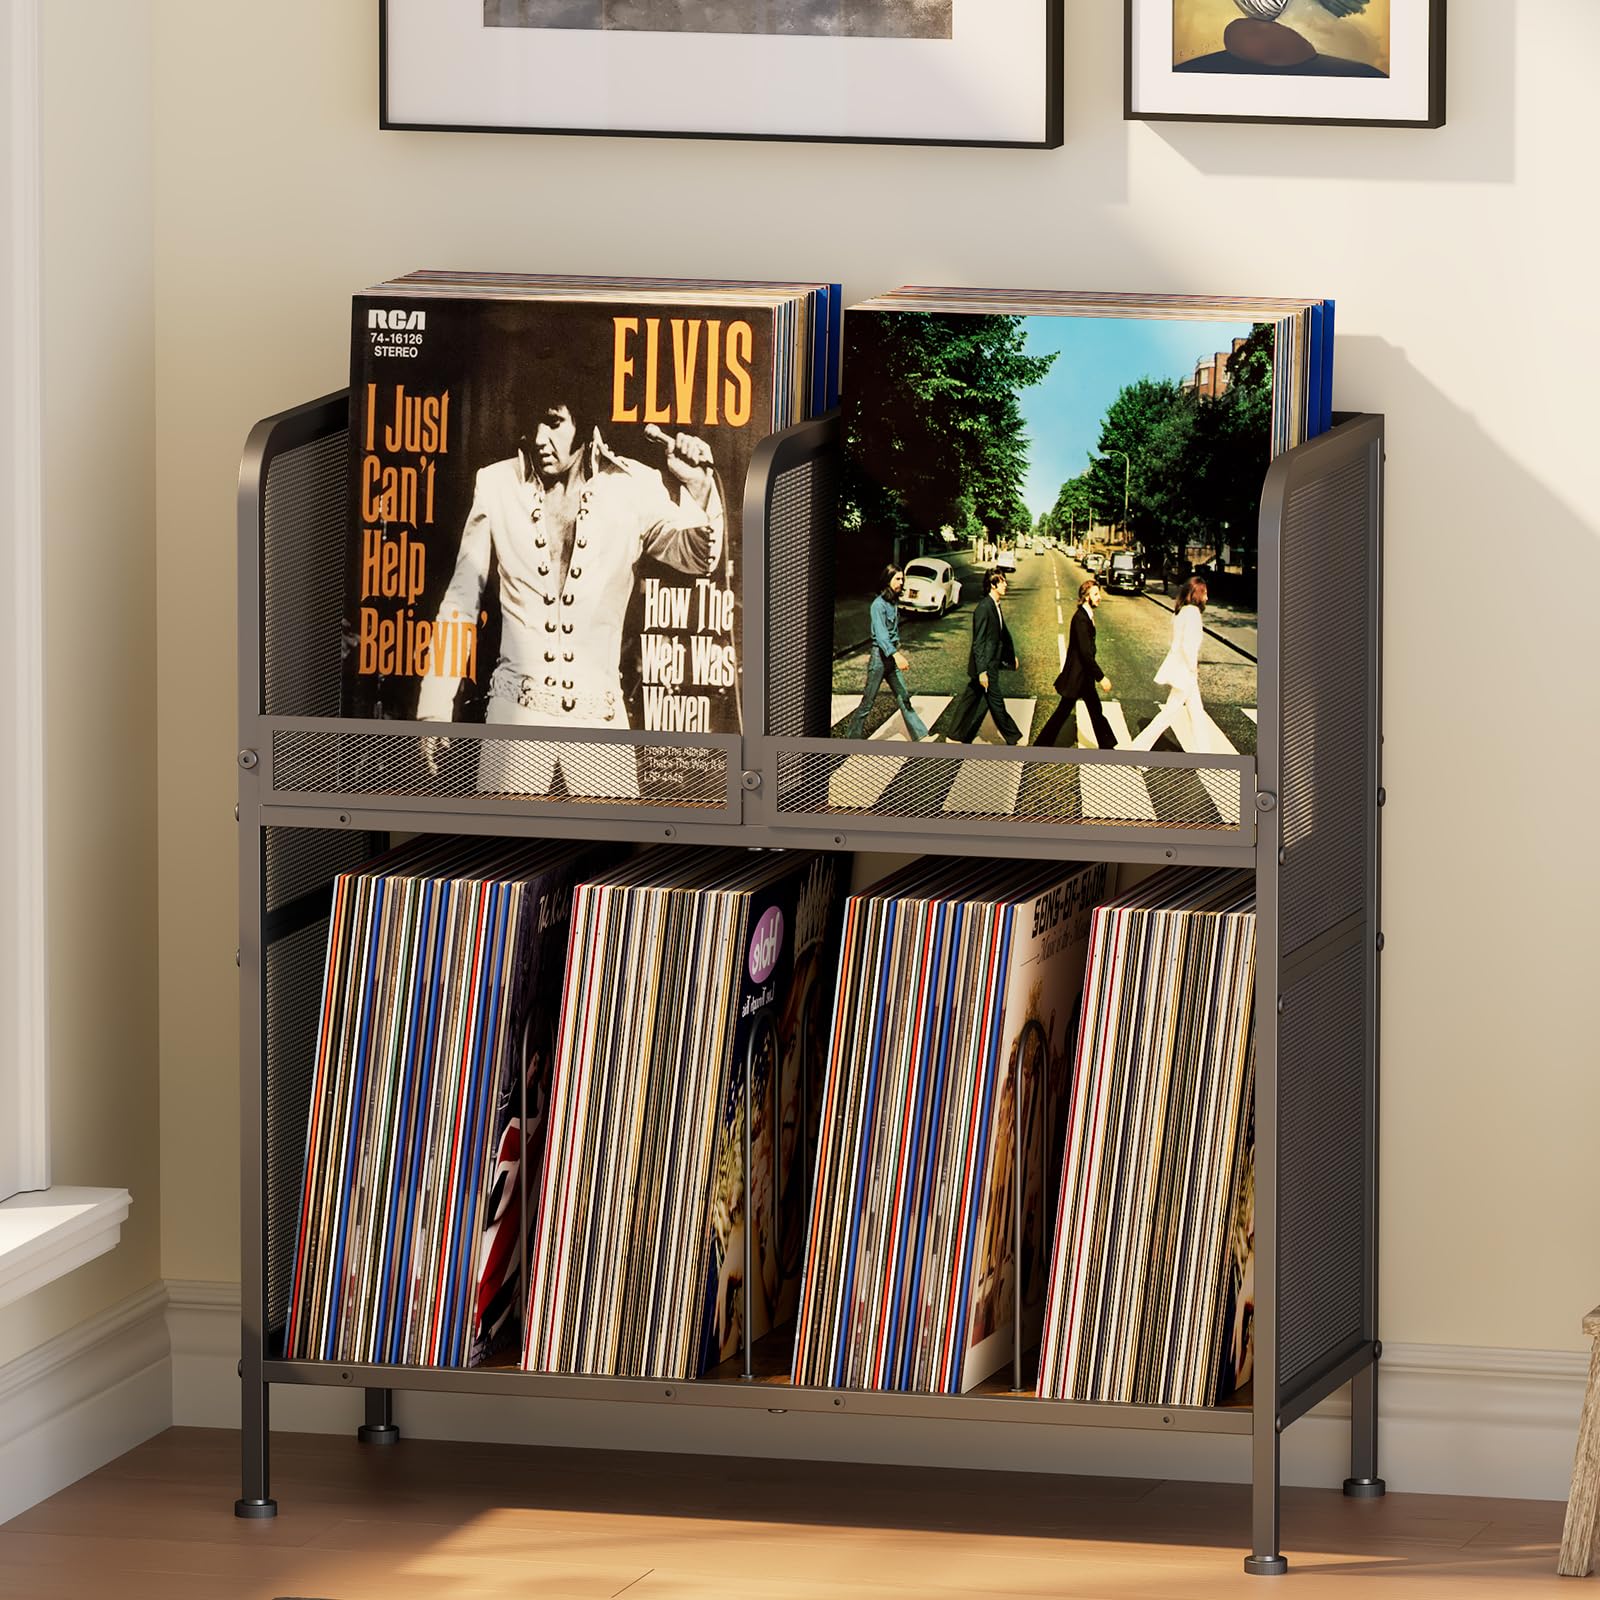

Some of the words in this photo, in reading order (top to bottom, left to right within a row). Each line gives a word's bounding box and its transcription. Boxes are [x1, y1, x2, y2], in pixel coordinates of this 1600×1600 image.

[368, 309, 426, 330] RCA
[370, 332, 423, 345] 74-16126
[374, 345, 418, 358] STEREO
[611, 317, 752, 427] ELVIS
[365, 383, 377, 451] I
[385, 384, 450, 453] Just
[361, 454, 436, 529] Can't
[360, 529, 426, 606] Help
[644, 578, 692, 631] How
[696, 578, 735, 636] The
[358, 606, 488, 685] Believin'
[640, 633, 687, 689] Web
[690, 635, 736, 687] Was
[642, 685, 712, 733] Woven
